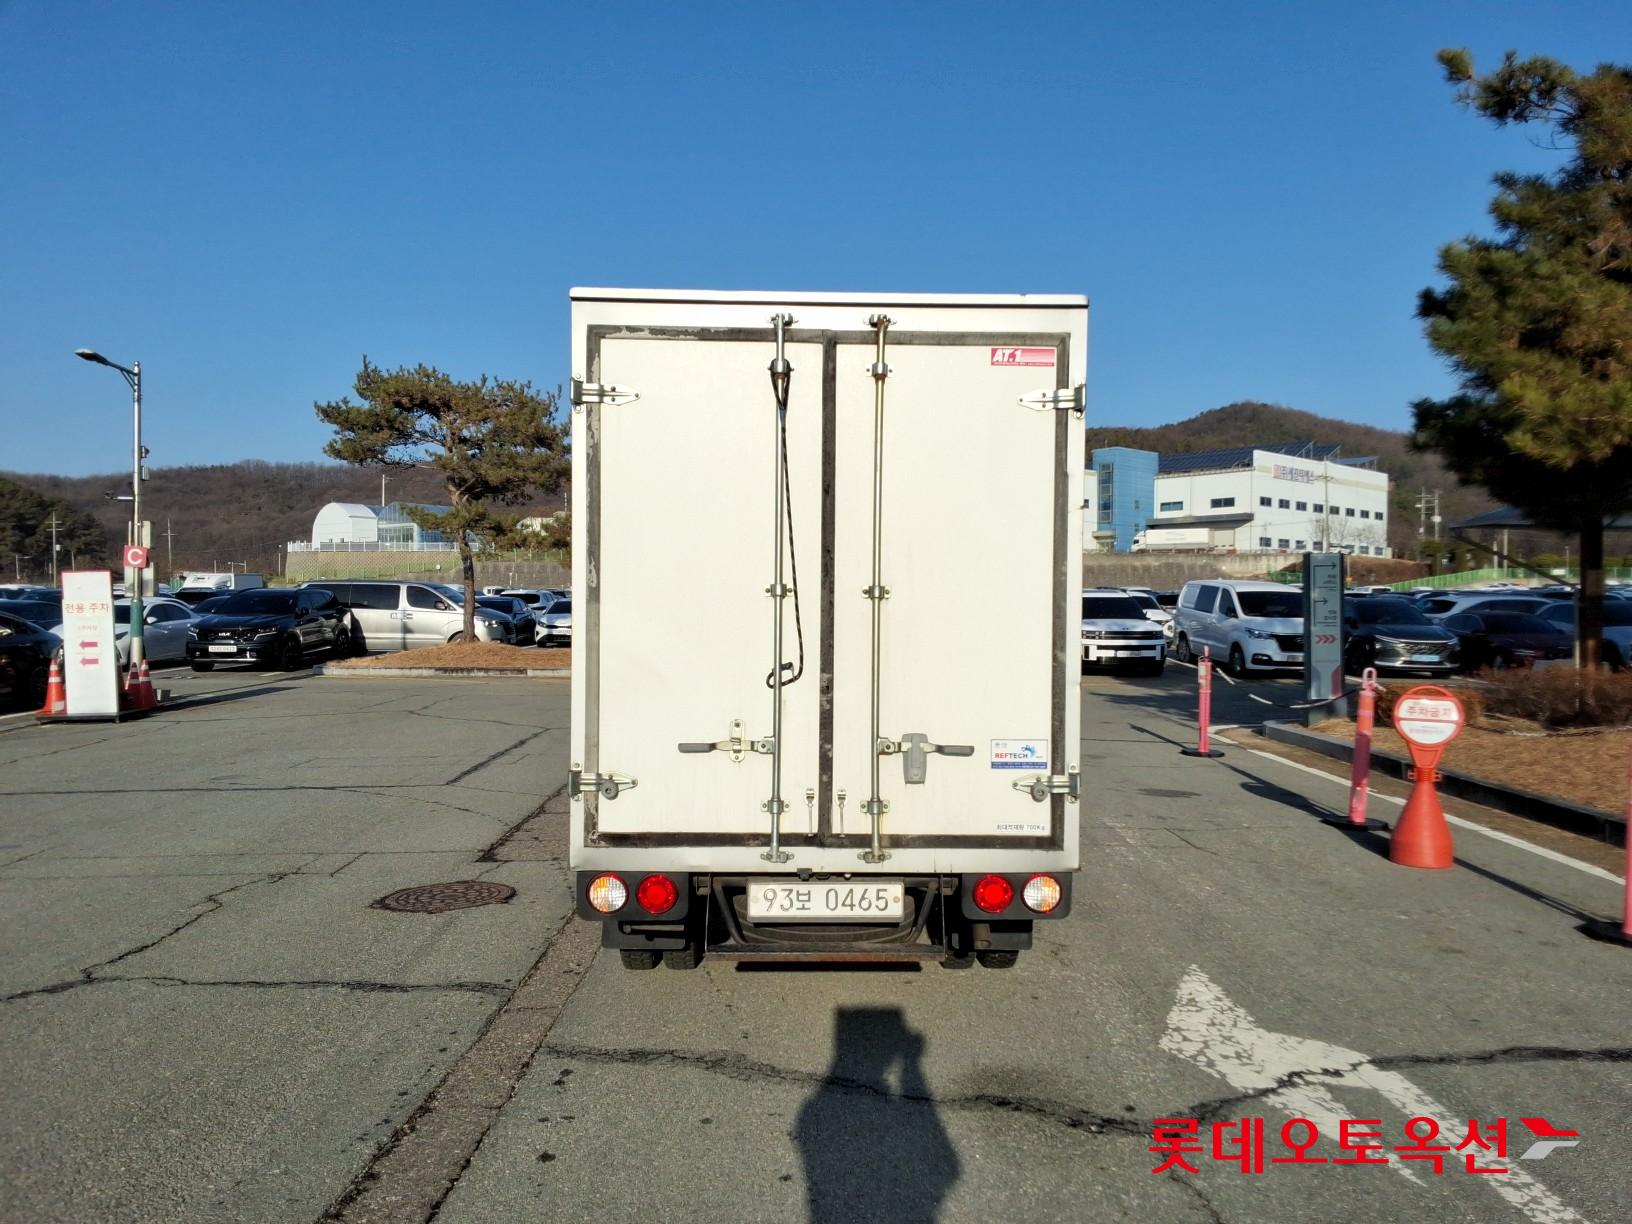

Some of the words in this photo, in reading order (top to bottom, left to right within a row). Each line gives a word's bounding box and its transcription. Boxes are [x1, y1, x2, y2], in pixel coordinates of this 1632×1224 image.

[127, 548, 143, 565] C
[65, 602, 85, 614] 전용
[89, 602, 110, 614] 주차
[763, 888, 811, 912] 93보
[825, 888, 889, 912] 0465
